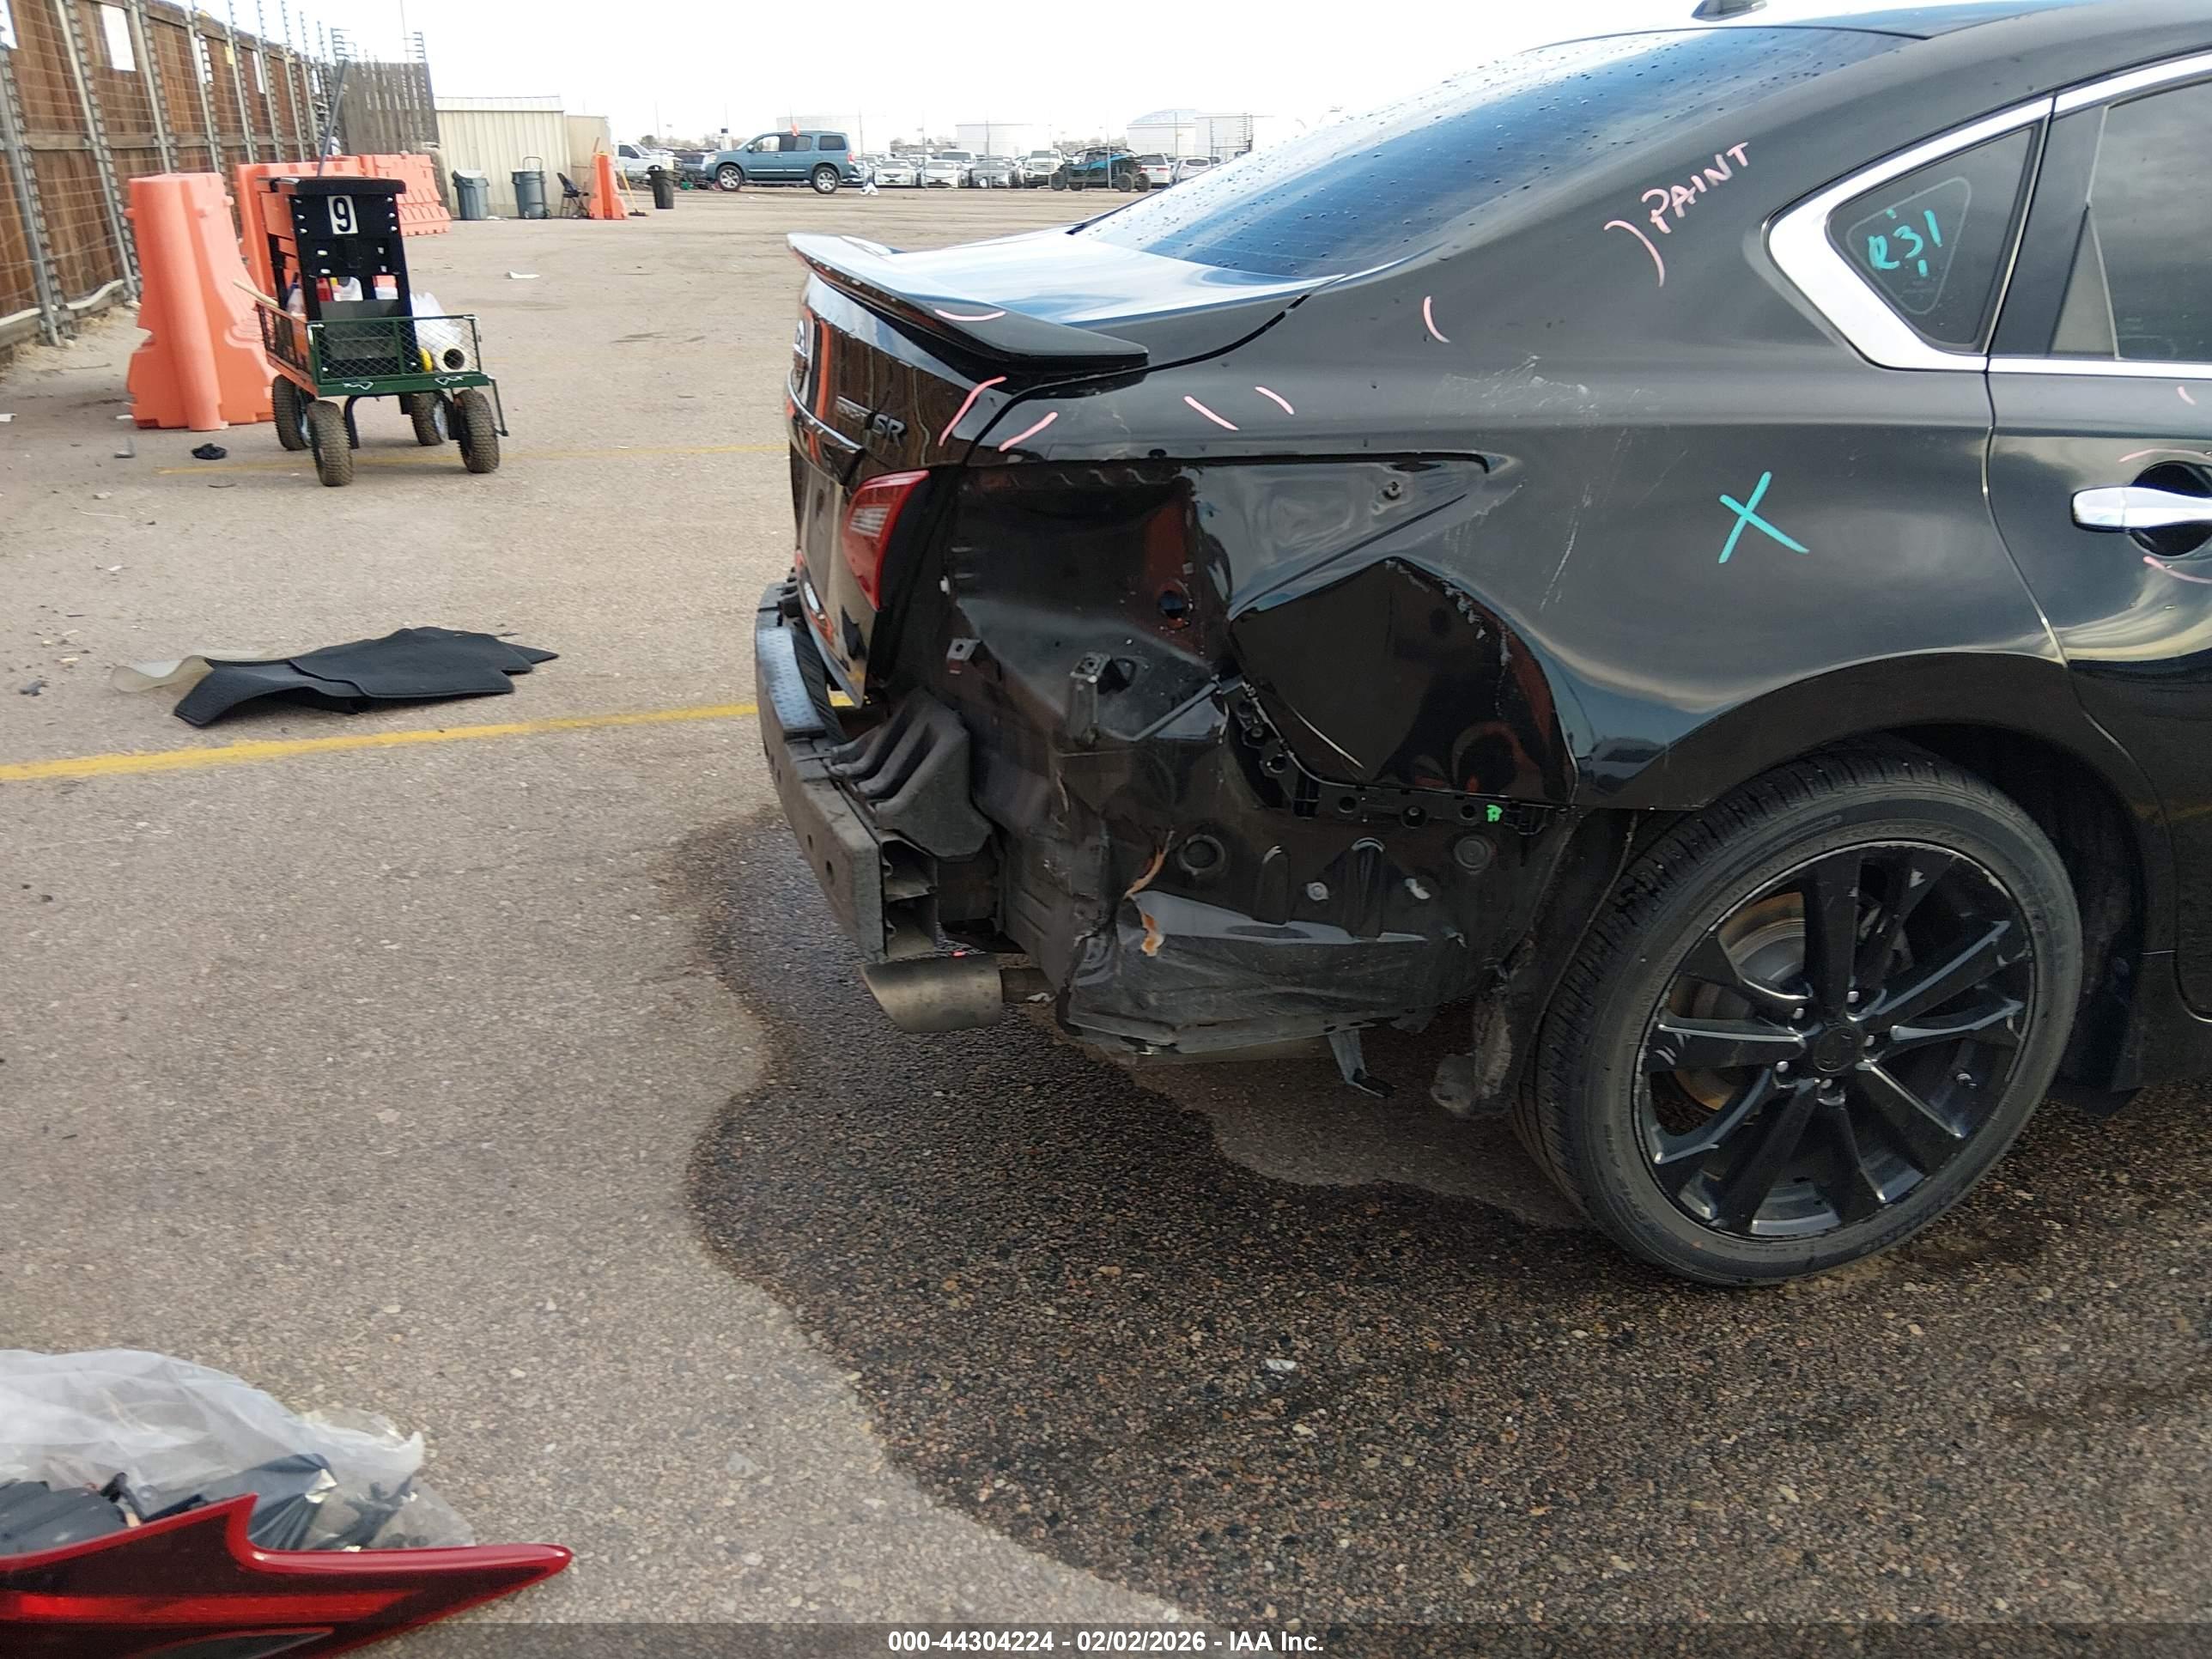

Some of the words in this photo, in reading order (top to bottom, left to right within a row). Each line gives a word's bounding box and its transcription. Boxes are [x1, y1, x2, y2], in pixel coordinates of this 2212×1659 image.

[1641, 142, 1749, 234] PAINT
[332, 197, 352, 233] 9
[871, 413, 906, 447] SR
